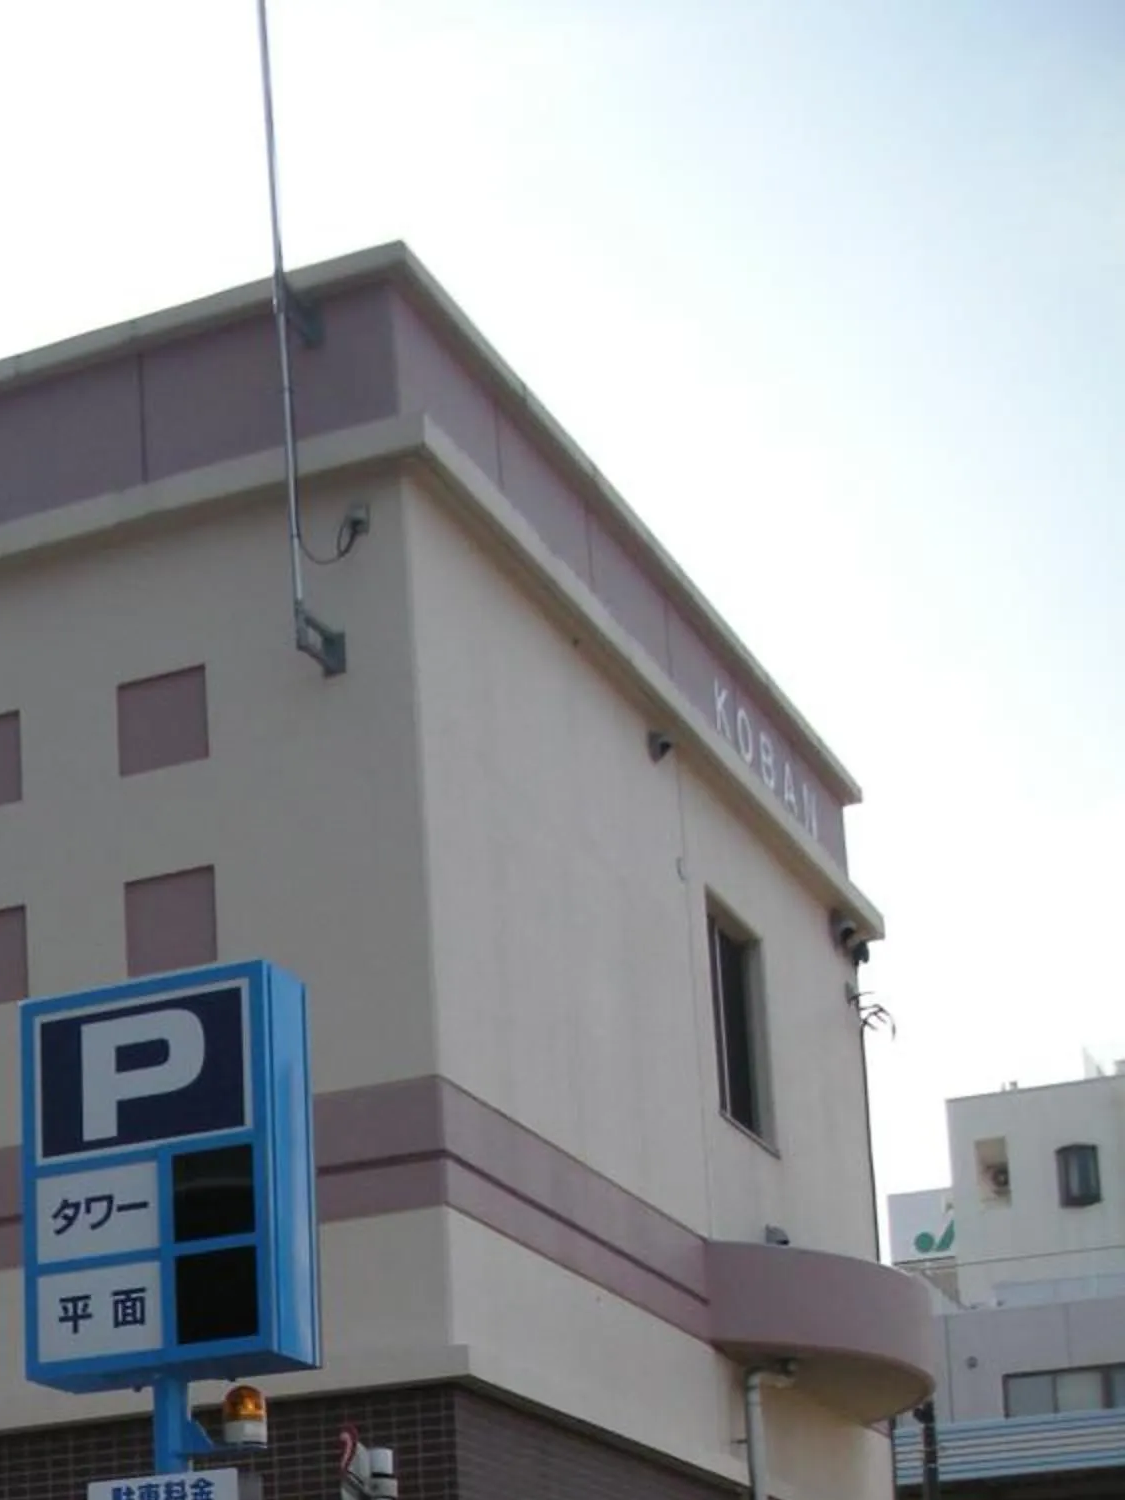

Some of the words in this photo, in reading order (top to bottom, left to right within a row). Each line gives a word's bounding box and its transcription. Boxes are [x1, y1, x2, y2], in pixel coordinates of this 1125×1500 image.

[81, 1008, 205, 1143] P
[51, 1193, 149, 1235] タワー
